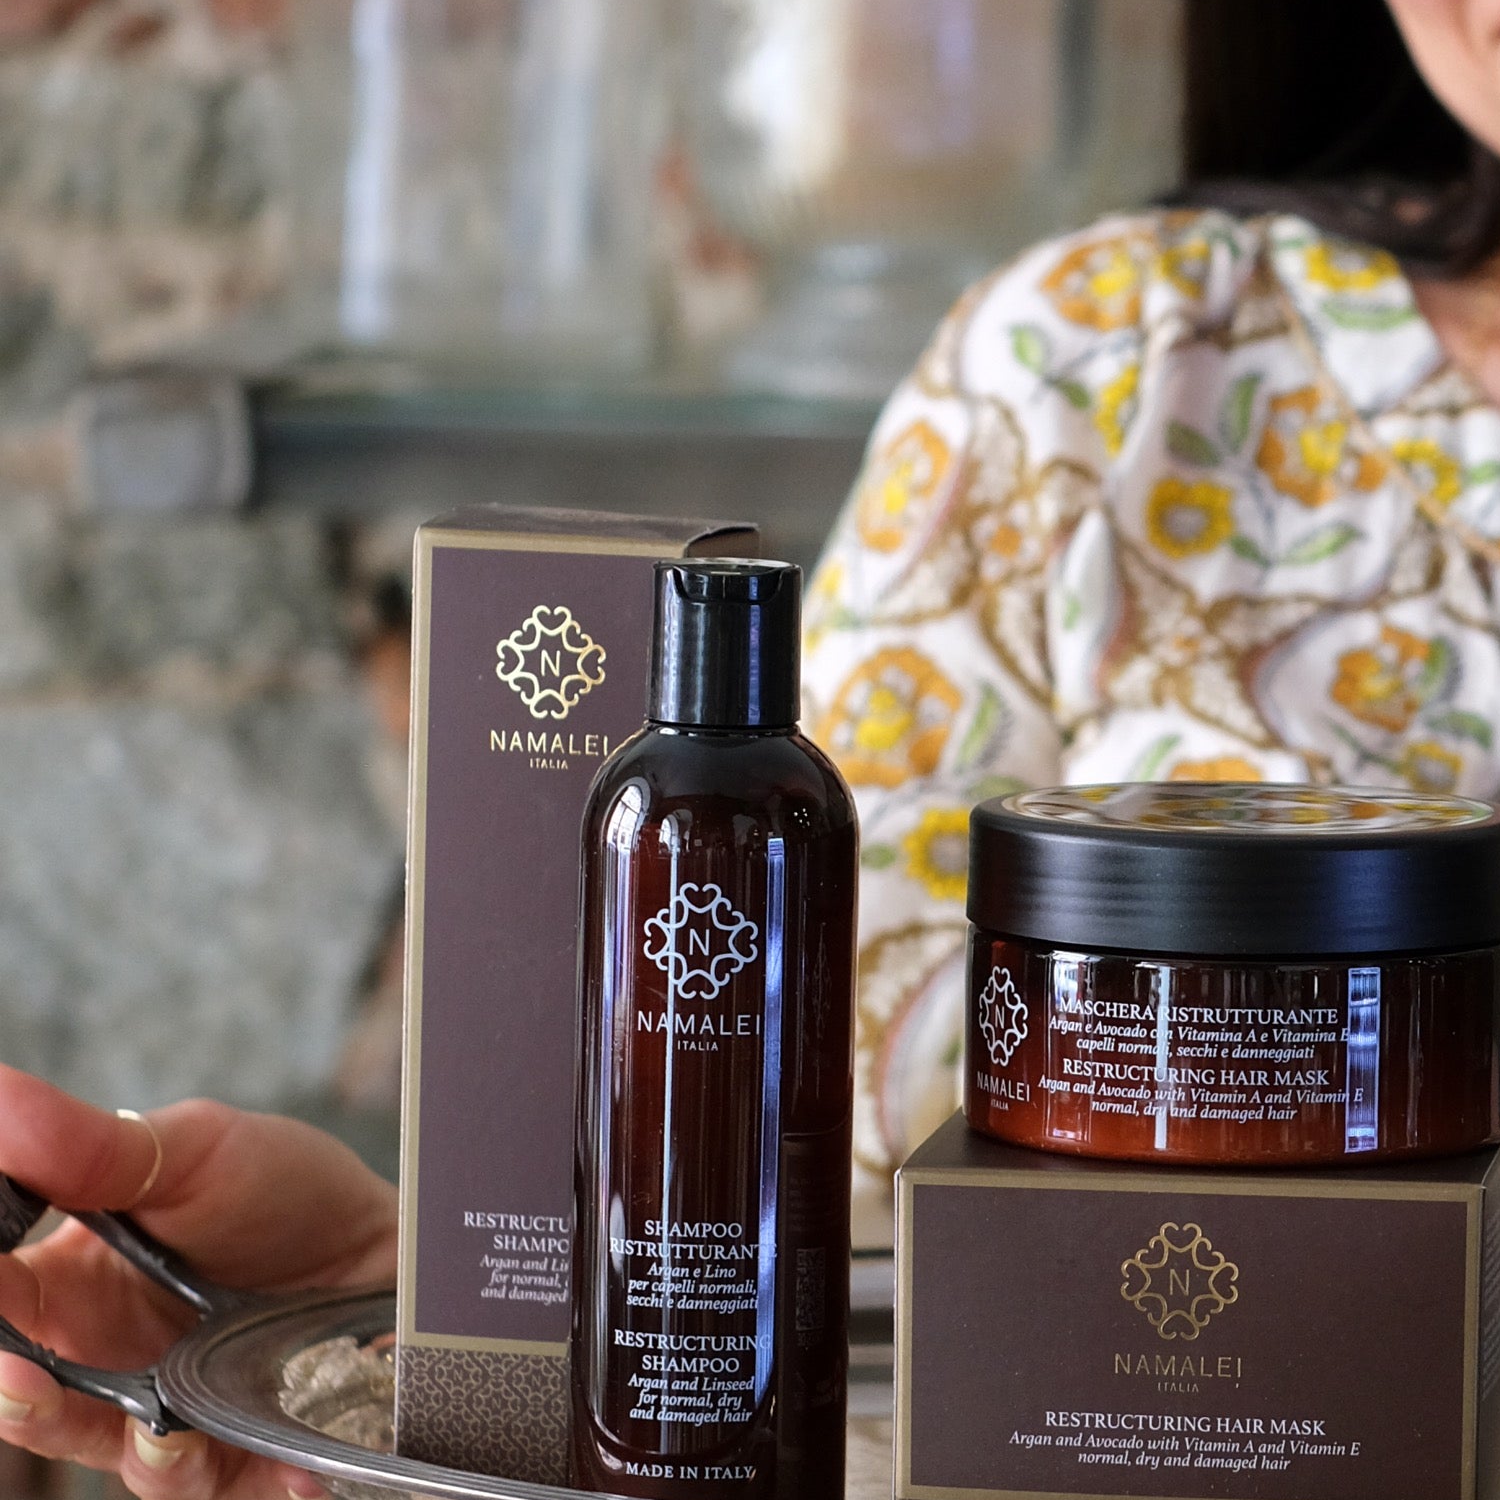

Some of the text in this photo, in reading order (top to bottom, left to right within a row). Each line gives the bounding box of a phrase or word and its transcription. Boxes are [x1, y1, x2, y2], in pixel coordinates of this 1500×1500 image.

[490, 729, 609, 757] NAMALEI
[529, 757, 569, 770] ITALIA
[1059, 998, 1338, 1025] MASCHERA RISTRUTTURANTE
[637, 1010, 761, 1036] NAMALEI
[1050, 1017, 1083, 1034] Argan
[1085, 1023, 1092, 1032] e
[1094, 1020, 1147, 1038] Avocado
[1178, 1027, 1242, 1042] Vitamina
[1245, 1030, 1256, 1042] A
[1260, 1033, 1268, 1043] e
[1273, 1029, 1336, 1043] Vitamina
[677, 1039, 719, 1051] ITALIA
[1077, 1037, 1115, 1053] capelli
[1177, 1045, 1218, 1057] secchi
[1221, 1048, 1229, 1057] e
[1232, 1045, 1315, 1063] danneggiati
[1063, 1058, 1330, 1086] RESTRUCTURING HAIR MASK
[977, 1071, 1030, 1102] NAMALEI
[1038, 1075, 1364, 1104] Argan and Avocado with Vitamin A and Vitamin E
[990, 1099, 1009, 1111] ITALIA
[1092, 1100, 1298, 1124] normal, dry and damaged hair
[464, 1211, 569, 1233] RESTRUCTU
[644, 1219, 742, 1238] SHAMPOO
[493, 1234, 569, 1253] SHAMPO
[610, 1237, 778, 1260] RISTRUTTURANTE
[480, 1254, 519, 1270] Argan
[523, 1258, 548, 1271] and
[647, 1262, 736, 1280] Argan e Lino
[489, 1269, 509, 1286] for
[512, 1273, 561, 1288] normal,
[628, 1279, 757, 1295] per capelli normali,
[481, 1285, 568, 1306] and damaged
[627, 1293, 759, 1314] secchi e danneggiati
[614, 1329, 771, 1351] RESTRUCTURING
[642, 1354, 739, 1373] SHAMPOO
[1115, 1353, 1241, 1378] NAMALEI
[628, 1373, 755, 1391] Argan and Linseed
[1157, 1382, 1199, 1393] ITALIA
[636, 1389, 742, 1410] for normal, dry
[629, 1407, 752, 1427] and damaged hair
[1045, 1411, 1326, 1436] RESTRUCTURING HAIR MASK
[1009, 1430, 1361, 1456] Argan and Avocado with Vitamin A and Vitamin E
[626, 1462, 753, 1479] MADE IN ITALY
[1078, 1450, 1291, 1473] normal, dry and damaged hair
